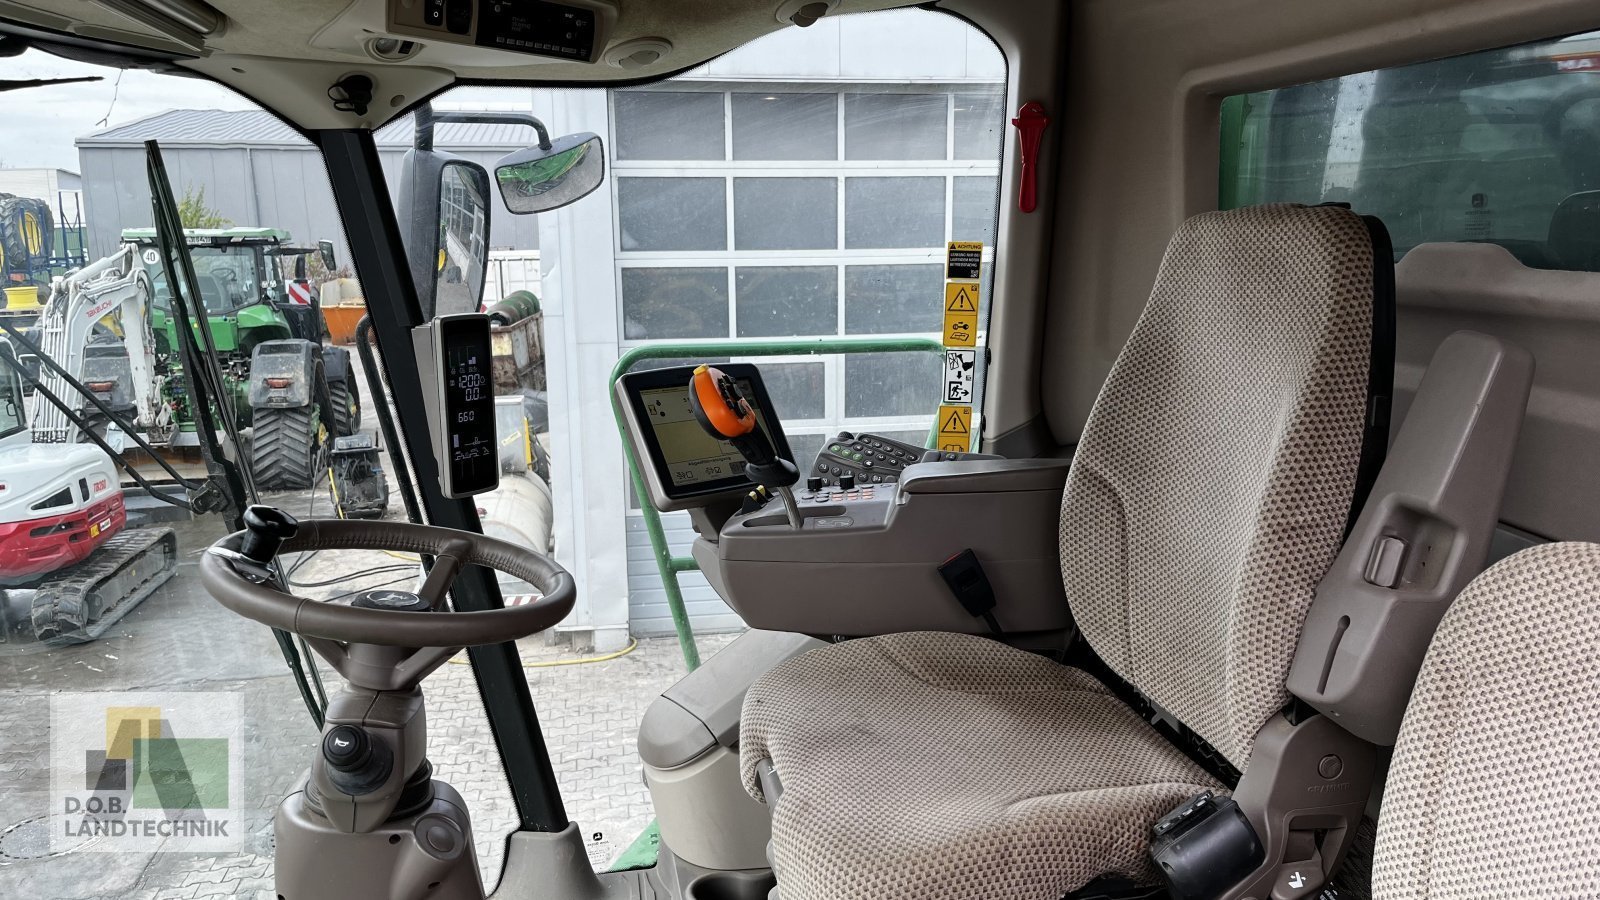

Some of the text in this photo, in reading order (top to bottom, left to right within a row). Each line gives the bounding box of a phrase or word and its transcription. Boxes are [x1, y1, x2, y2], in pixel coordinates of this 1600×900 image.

[145, 251, 156, 262] 40
[85, 299, 113, 318] TAKEUCHI
[465, 387, 480, 401] 0.0
[458, 410, 475, 423] 660
